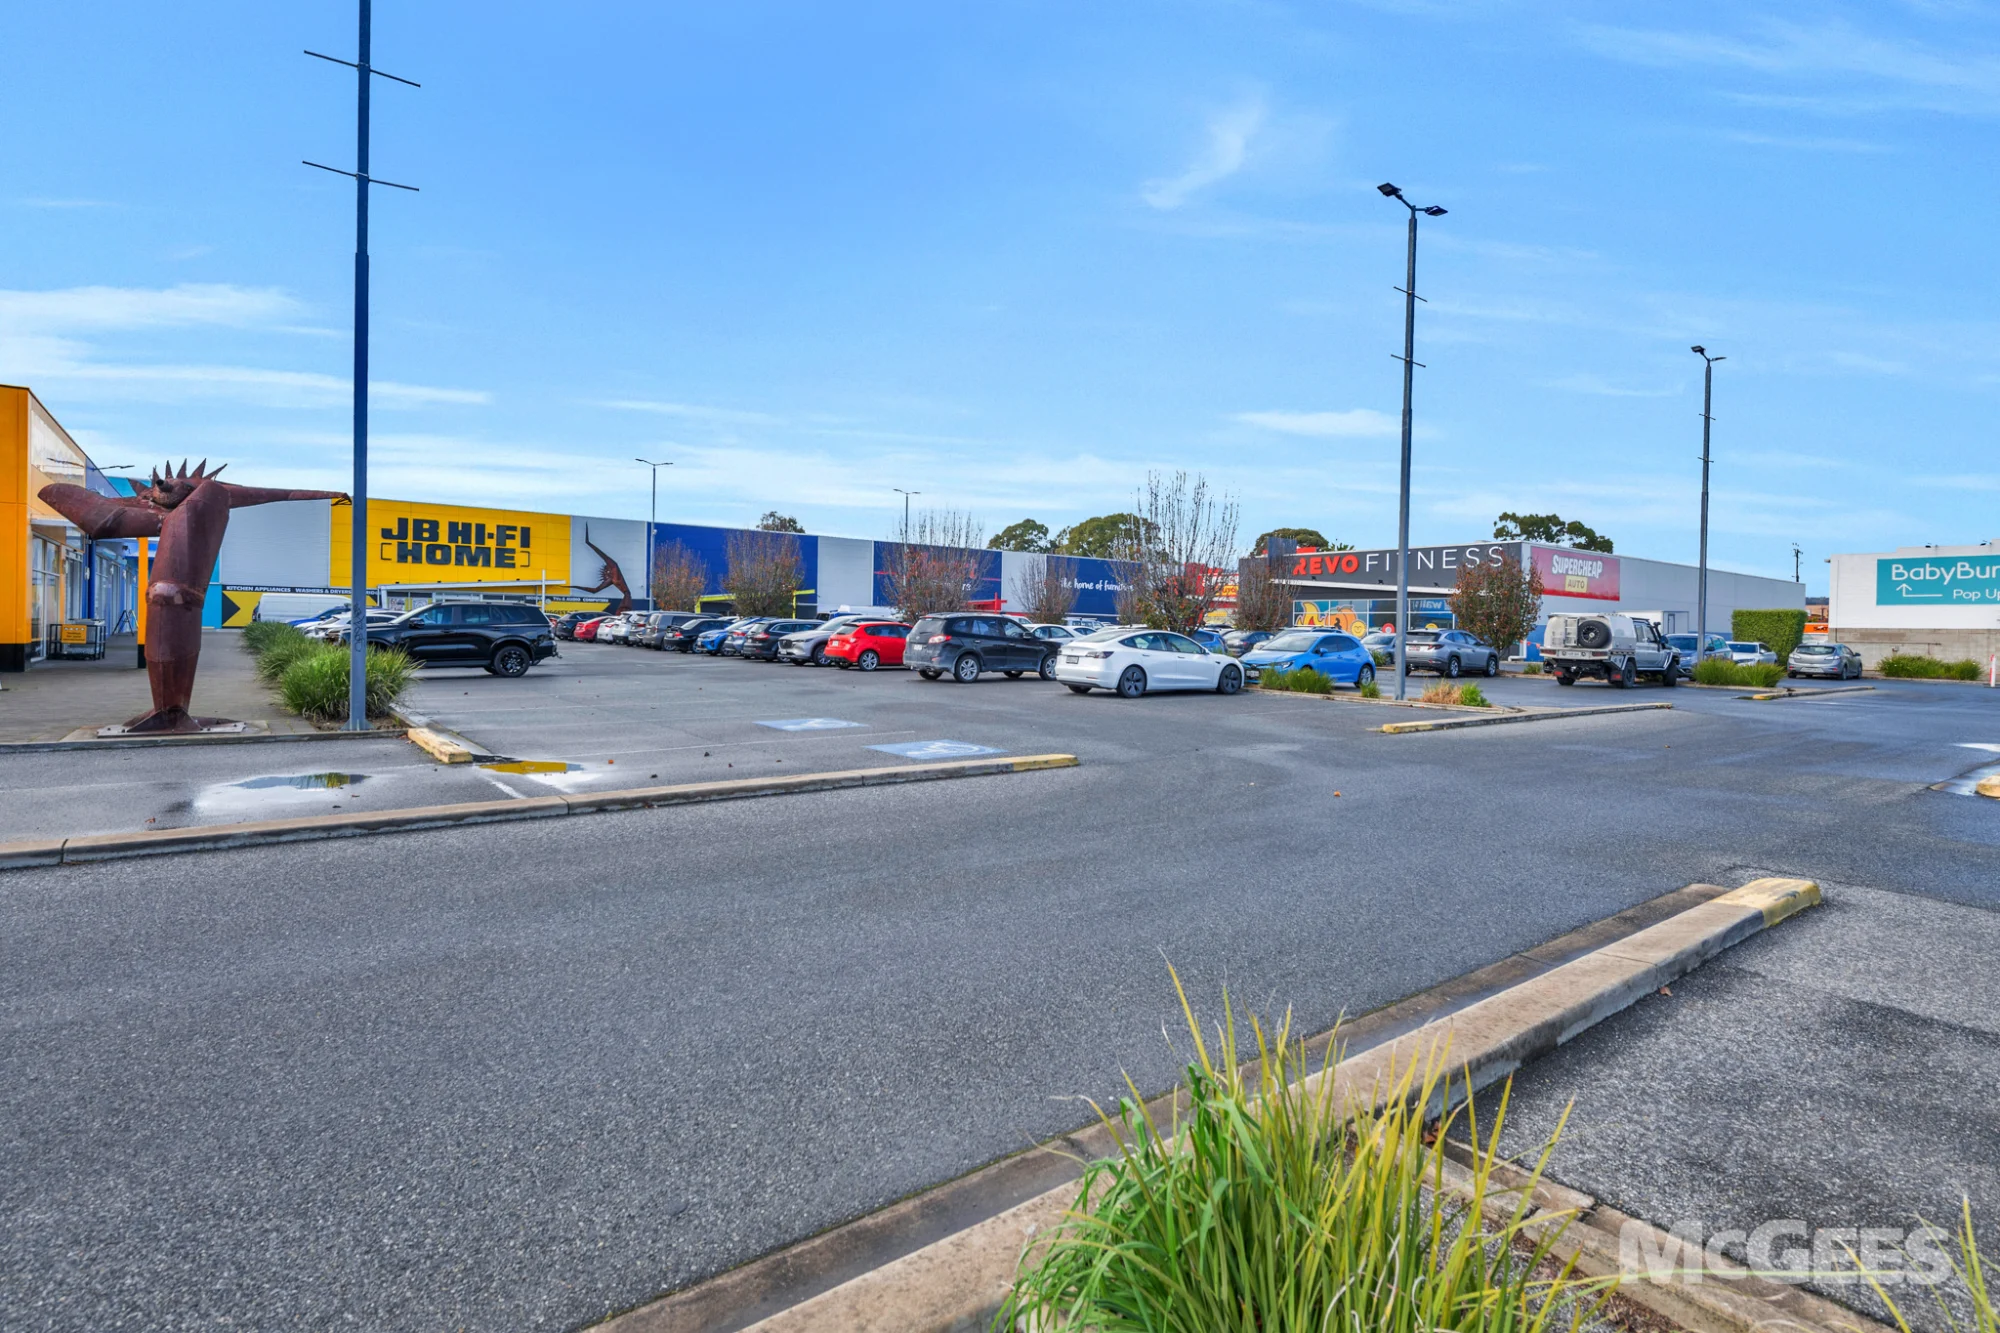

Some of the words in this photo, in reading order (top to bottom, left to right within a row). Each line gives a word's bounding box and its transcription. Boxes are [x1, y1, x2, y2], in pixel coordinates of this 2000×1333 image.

[381, 517, 440, 542] JB
[448, 521, 531, 548] HI-FI
[396, 541, 516, 568] HOME
[1292, 554, 1360, 576] REVO
[1365, 546, 1504, 573] FINESS
[1552, 554, 1603, 579] SUPERCHEAP
[1074, 578, 1094, 590] home
[1095, 580, 1103, 591] of
[1104, 580, 1134, 592] furnite
[1567, 579, 1585, 589] AUTO
[1953, 589, 1981, 602] Pop
